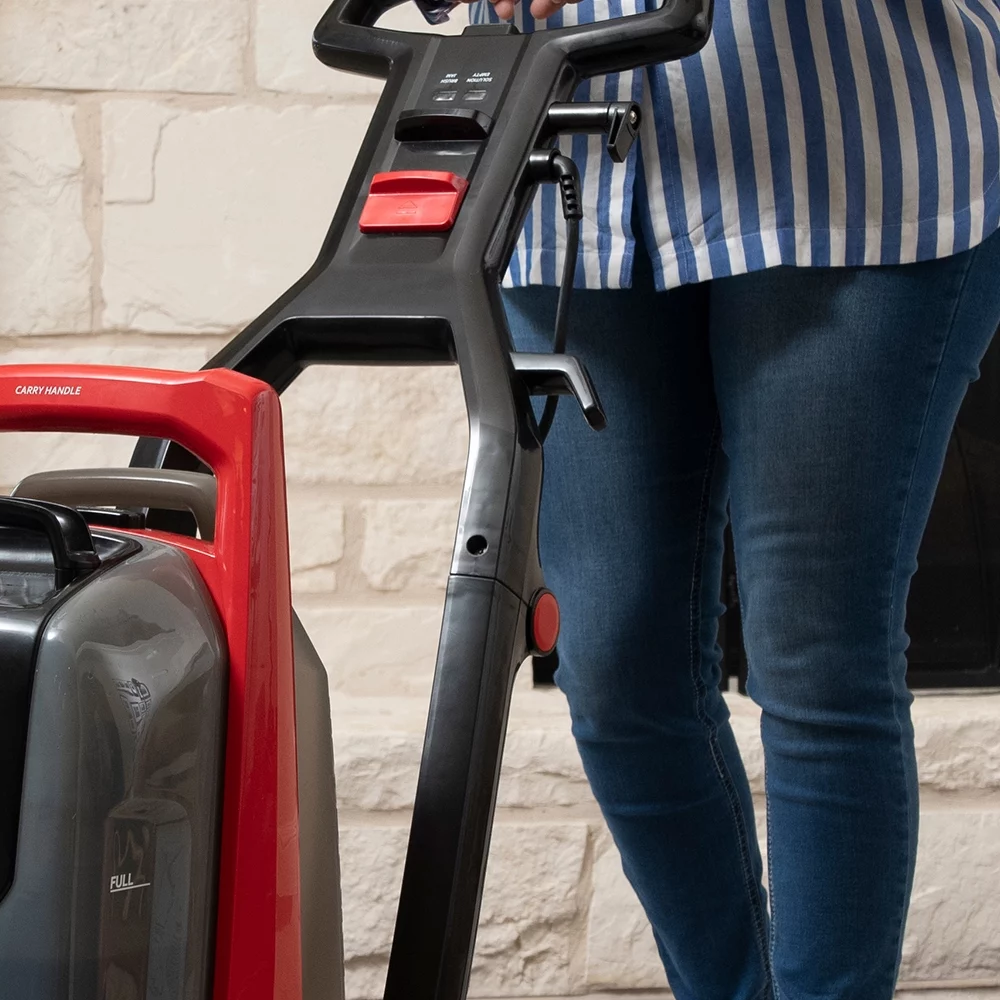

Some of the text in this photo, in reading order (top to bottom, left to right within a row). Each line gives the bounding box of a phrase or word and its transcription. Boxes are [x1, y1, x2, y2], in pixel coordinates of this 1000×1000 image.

[15, 385, 82, 395] CARRY HANDLE
[110, 872, 134, 890] FULL
